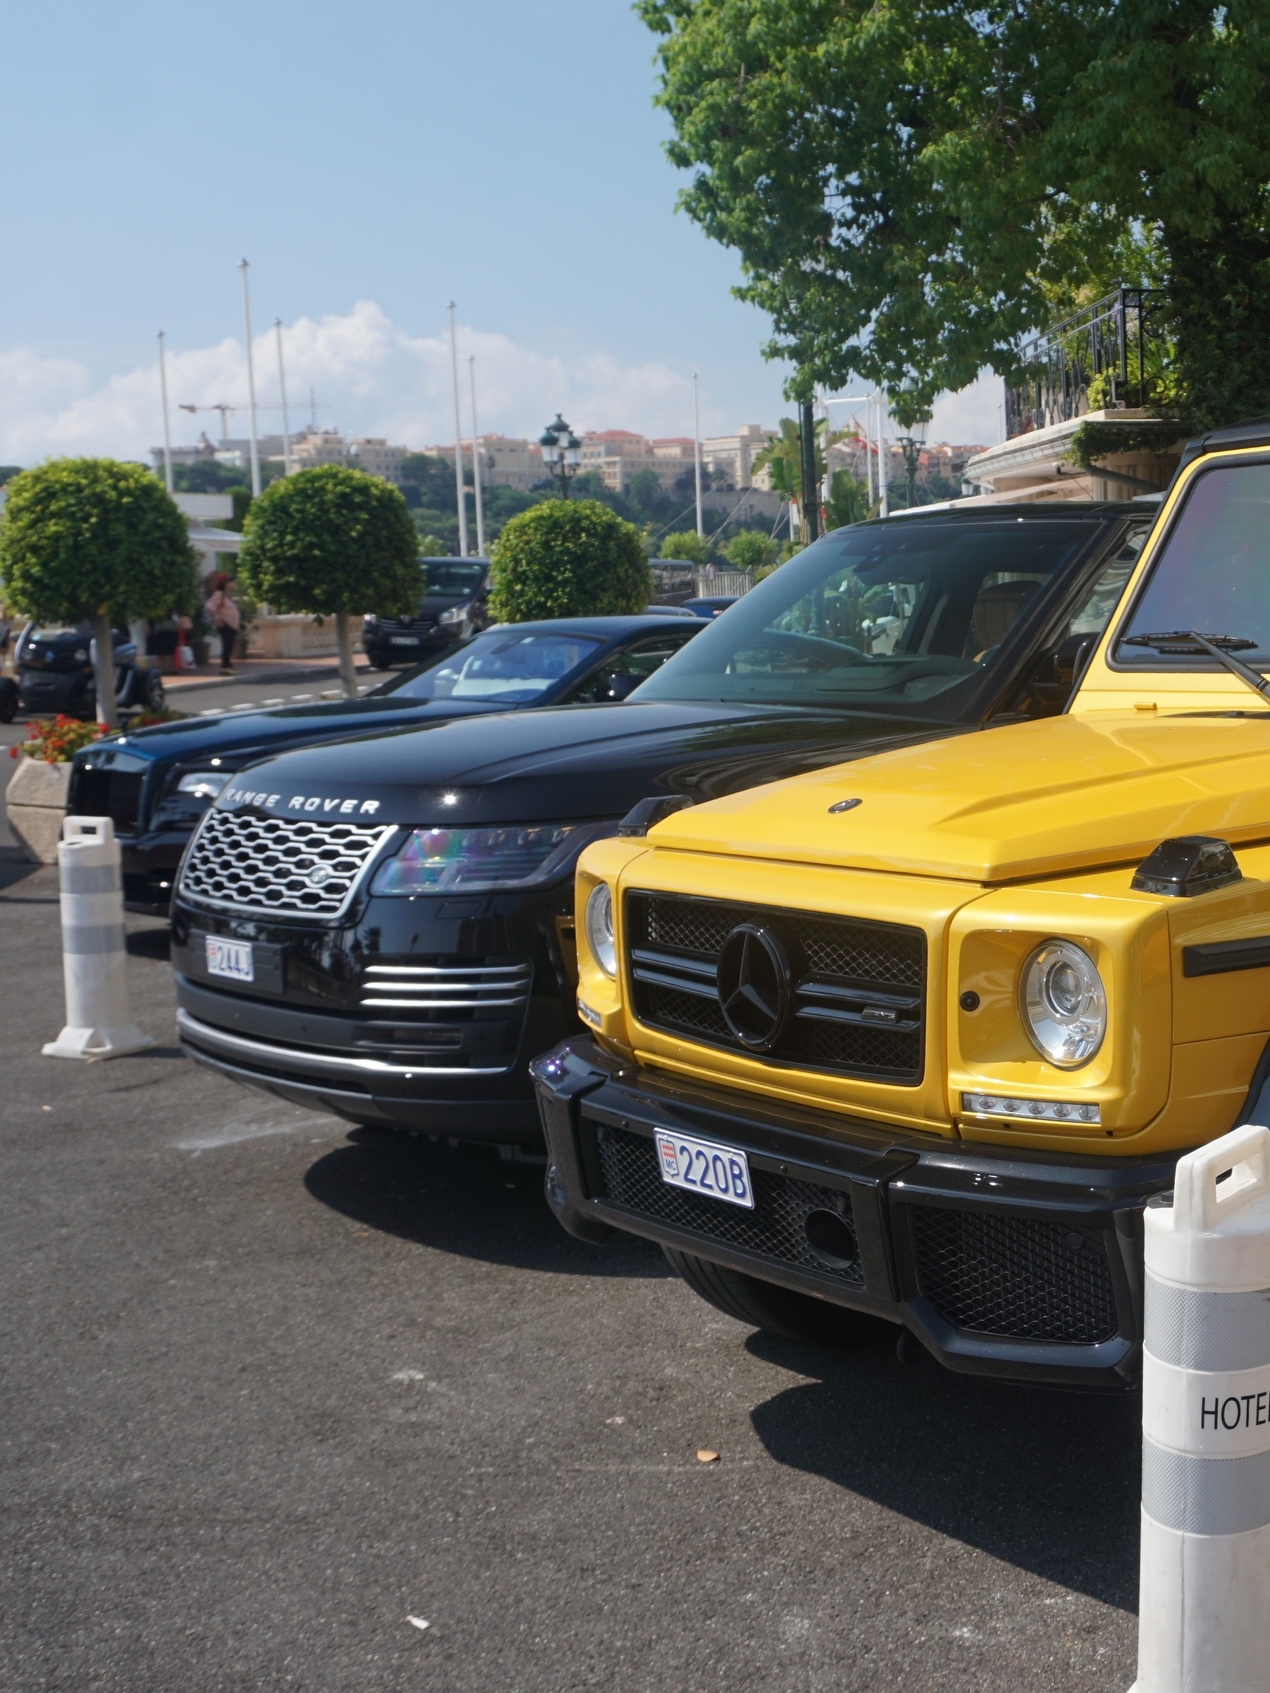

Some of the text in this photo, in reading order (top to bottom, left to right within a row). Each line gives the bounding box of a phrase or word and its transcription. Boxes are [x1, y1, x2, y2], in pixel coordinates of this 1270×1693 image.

[223, 790, 380, 814] RANGE ROVER
[679, 1144, 747, 1198] 220B
